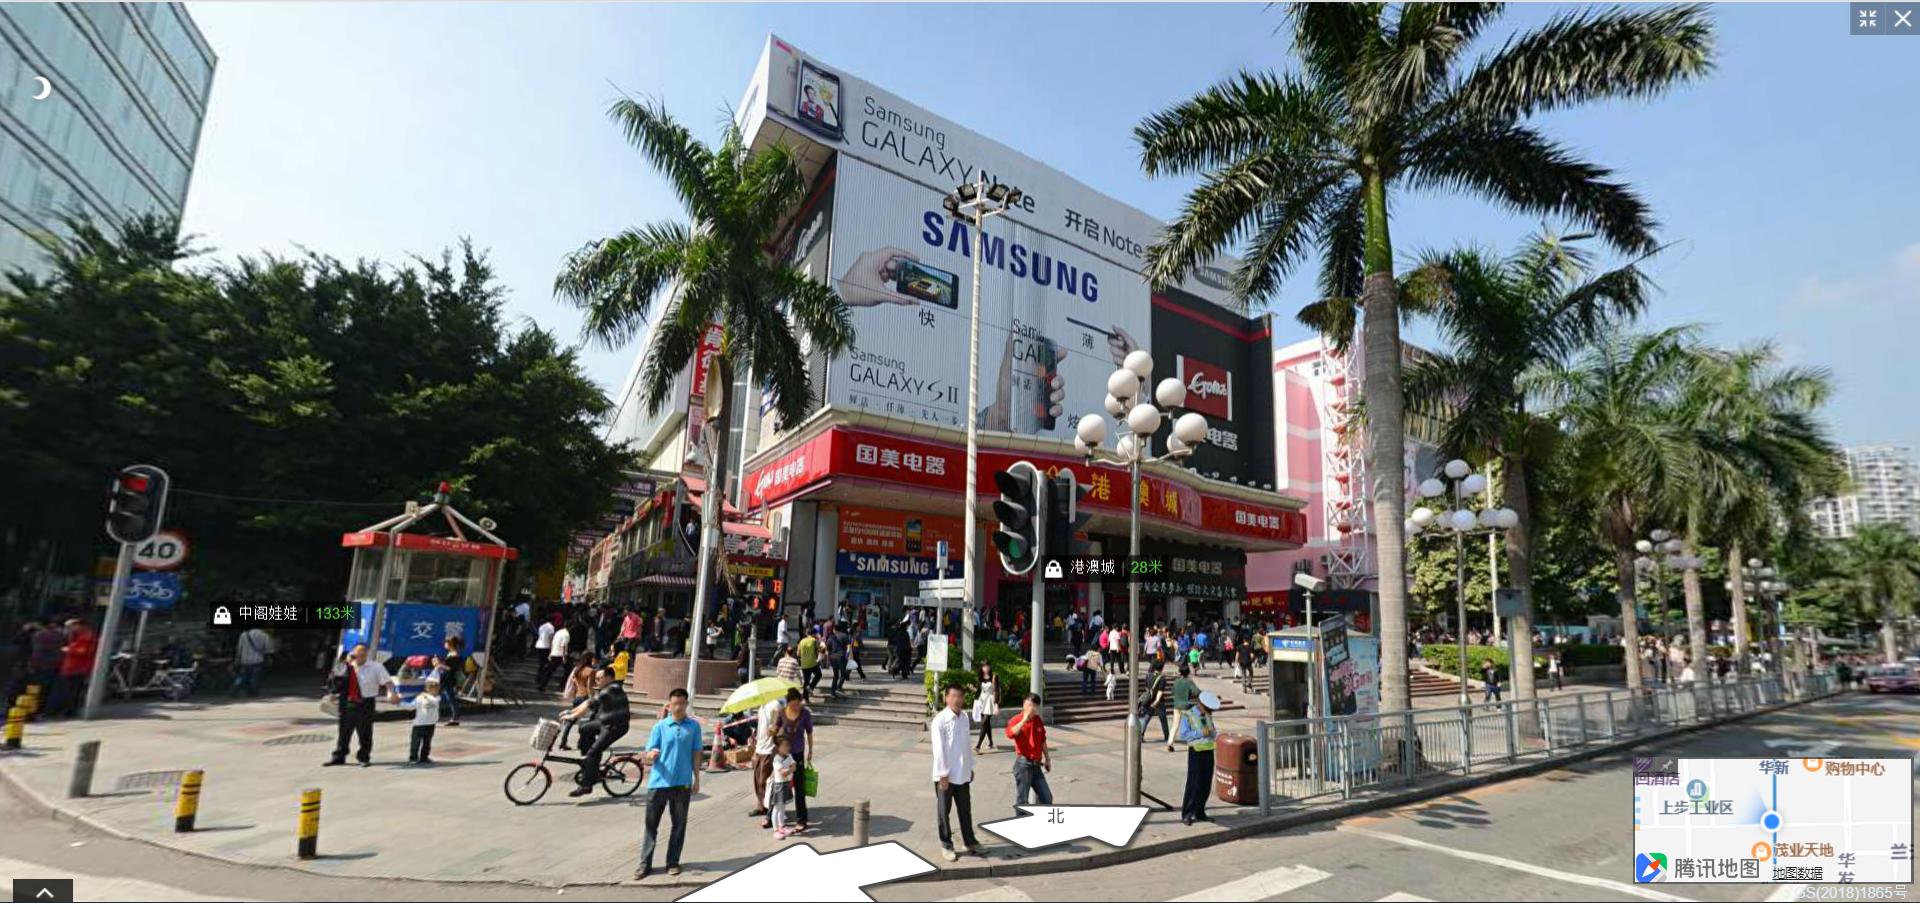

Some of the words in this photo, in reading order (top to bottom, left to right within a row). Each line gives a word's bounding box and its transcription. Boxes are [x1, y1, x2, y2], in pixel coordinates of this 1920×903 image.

[864, 95, 945, 150] Samsung
[862, 120, 973, 185] GALAXY
[1064, 207, 1099, 241] 开启
[1103, 226, 1143, 259] Note
[922, 209, 1099, 302] SAMSUNG
[918, 307, 935, 328] 快
[1082, 332, 1095, 350] 薄
[850, 346, 905, 375] Samsung
[850, 363, 924, 396] GALAXY
[947, 385, 959, 404] II
[1206, 427, 1238, 452] 电器
[855, 443, 946, 476] 国美电器
[1235, 510, 1280, 530] 国美电器
[138, 541, 176, 559] 40
[857, 556, 929, 576] SAMSUNG
[1172, 557, 1223, 575] 国美电器
